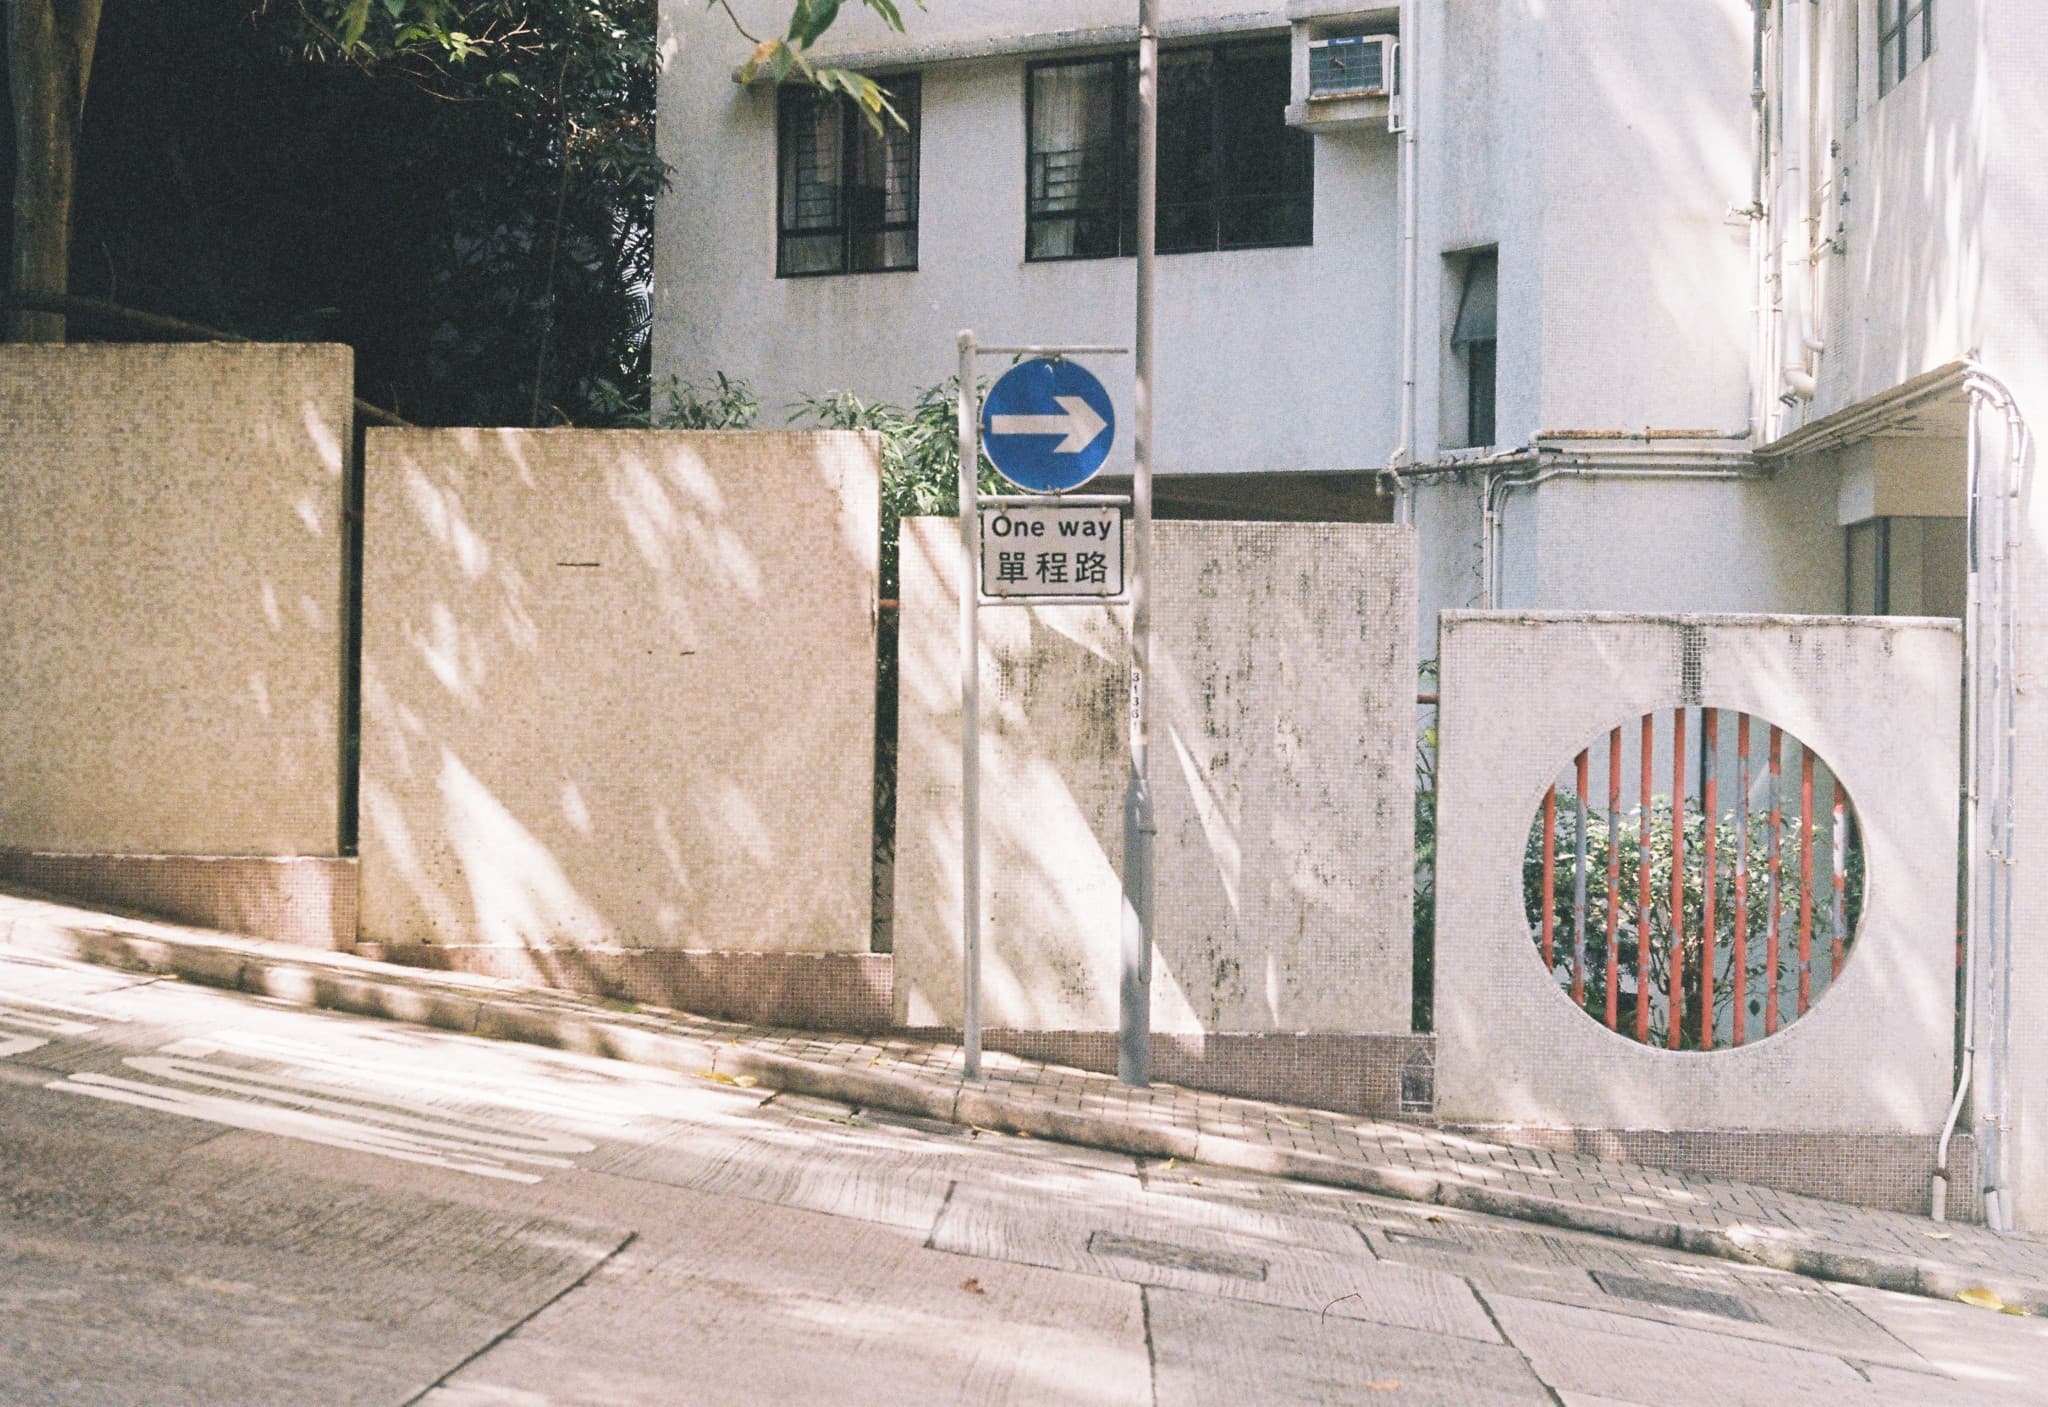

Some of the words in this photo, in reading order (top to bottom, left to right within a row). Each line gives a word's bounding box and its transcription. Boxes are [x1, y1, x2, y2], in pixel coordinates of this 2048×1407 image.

[991, 515, 1045, 537] One
[1058, 520, 1111, 541] way
[996, 551, 1108, 584] 單程路
